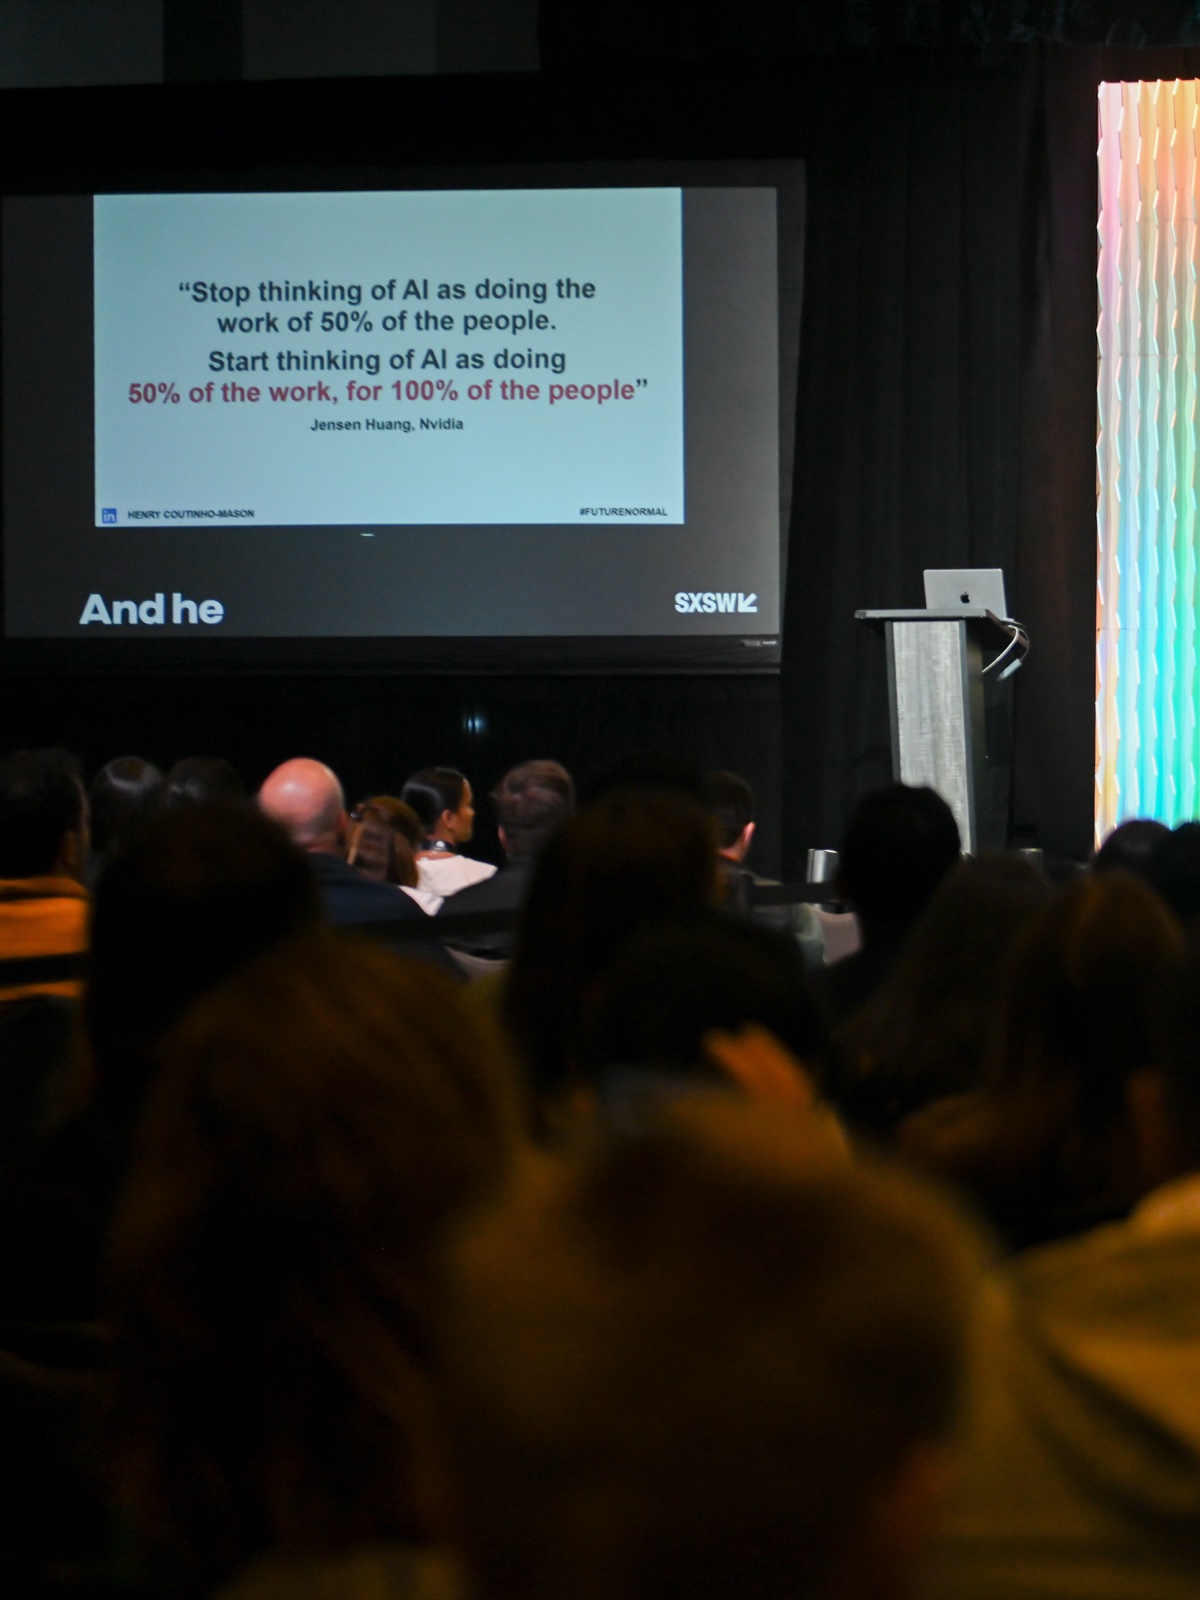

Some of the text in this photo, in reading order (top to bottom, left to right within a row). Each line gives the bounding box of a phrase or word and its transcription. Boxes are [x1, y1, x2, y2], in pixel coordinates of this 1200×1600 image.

[179, 278, 596, 307] “Stop thinking of AI as doing the
[216, 310, 556, 335] work of 50% of the people.
[208, 349, 566, 376] Start thinking of AI as doing
[128, 378, 648, 405] 50% of the work, for 100% of the people”
[310, 418, 464, 433] Jensen Huang, Nvidia
[127, 509, 255, 519] HENRY COUTINHO-MASON
[579, 507, 668, 517] #FUTURENORMAL
[78, 593, 224, 625] And he
[674, 592, 737, 613] SXSW
